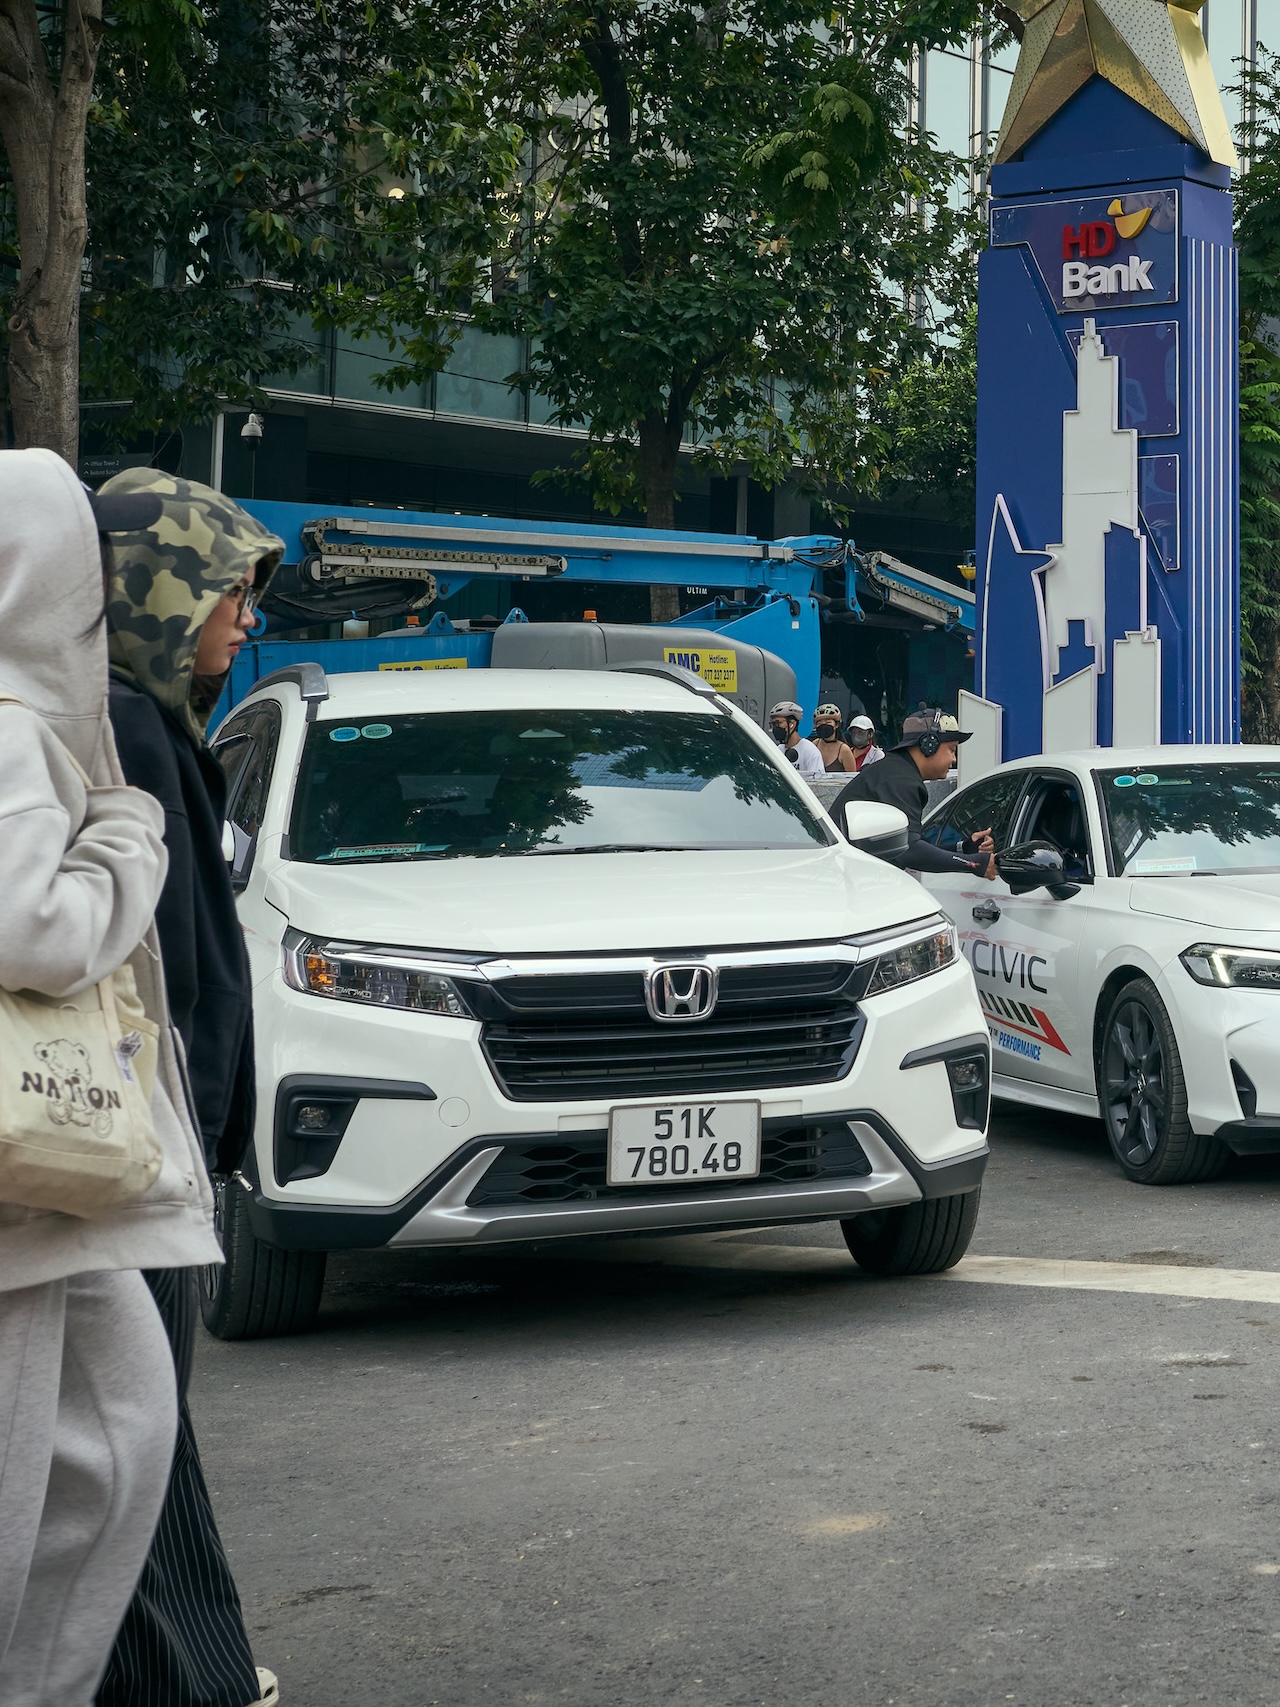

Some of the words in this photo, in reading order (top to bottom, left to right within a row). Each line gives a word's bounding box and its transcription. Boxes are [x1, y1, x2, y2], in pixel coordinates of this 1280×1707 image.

[1062, 221, 1117, 260] HD
[1062, 255, 1154, 298] Bank
[704, 669, 713, 680] 077
[971, 939, 1048, 995] CIVIC
[998, 1031, 1041, 1061] PERFORMANCE
[654, 1107, 717, 1140] 51K
[627, 1141, 742, 1178] 780.48
